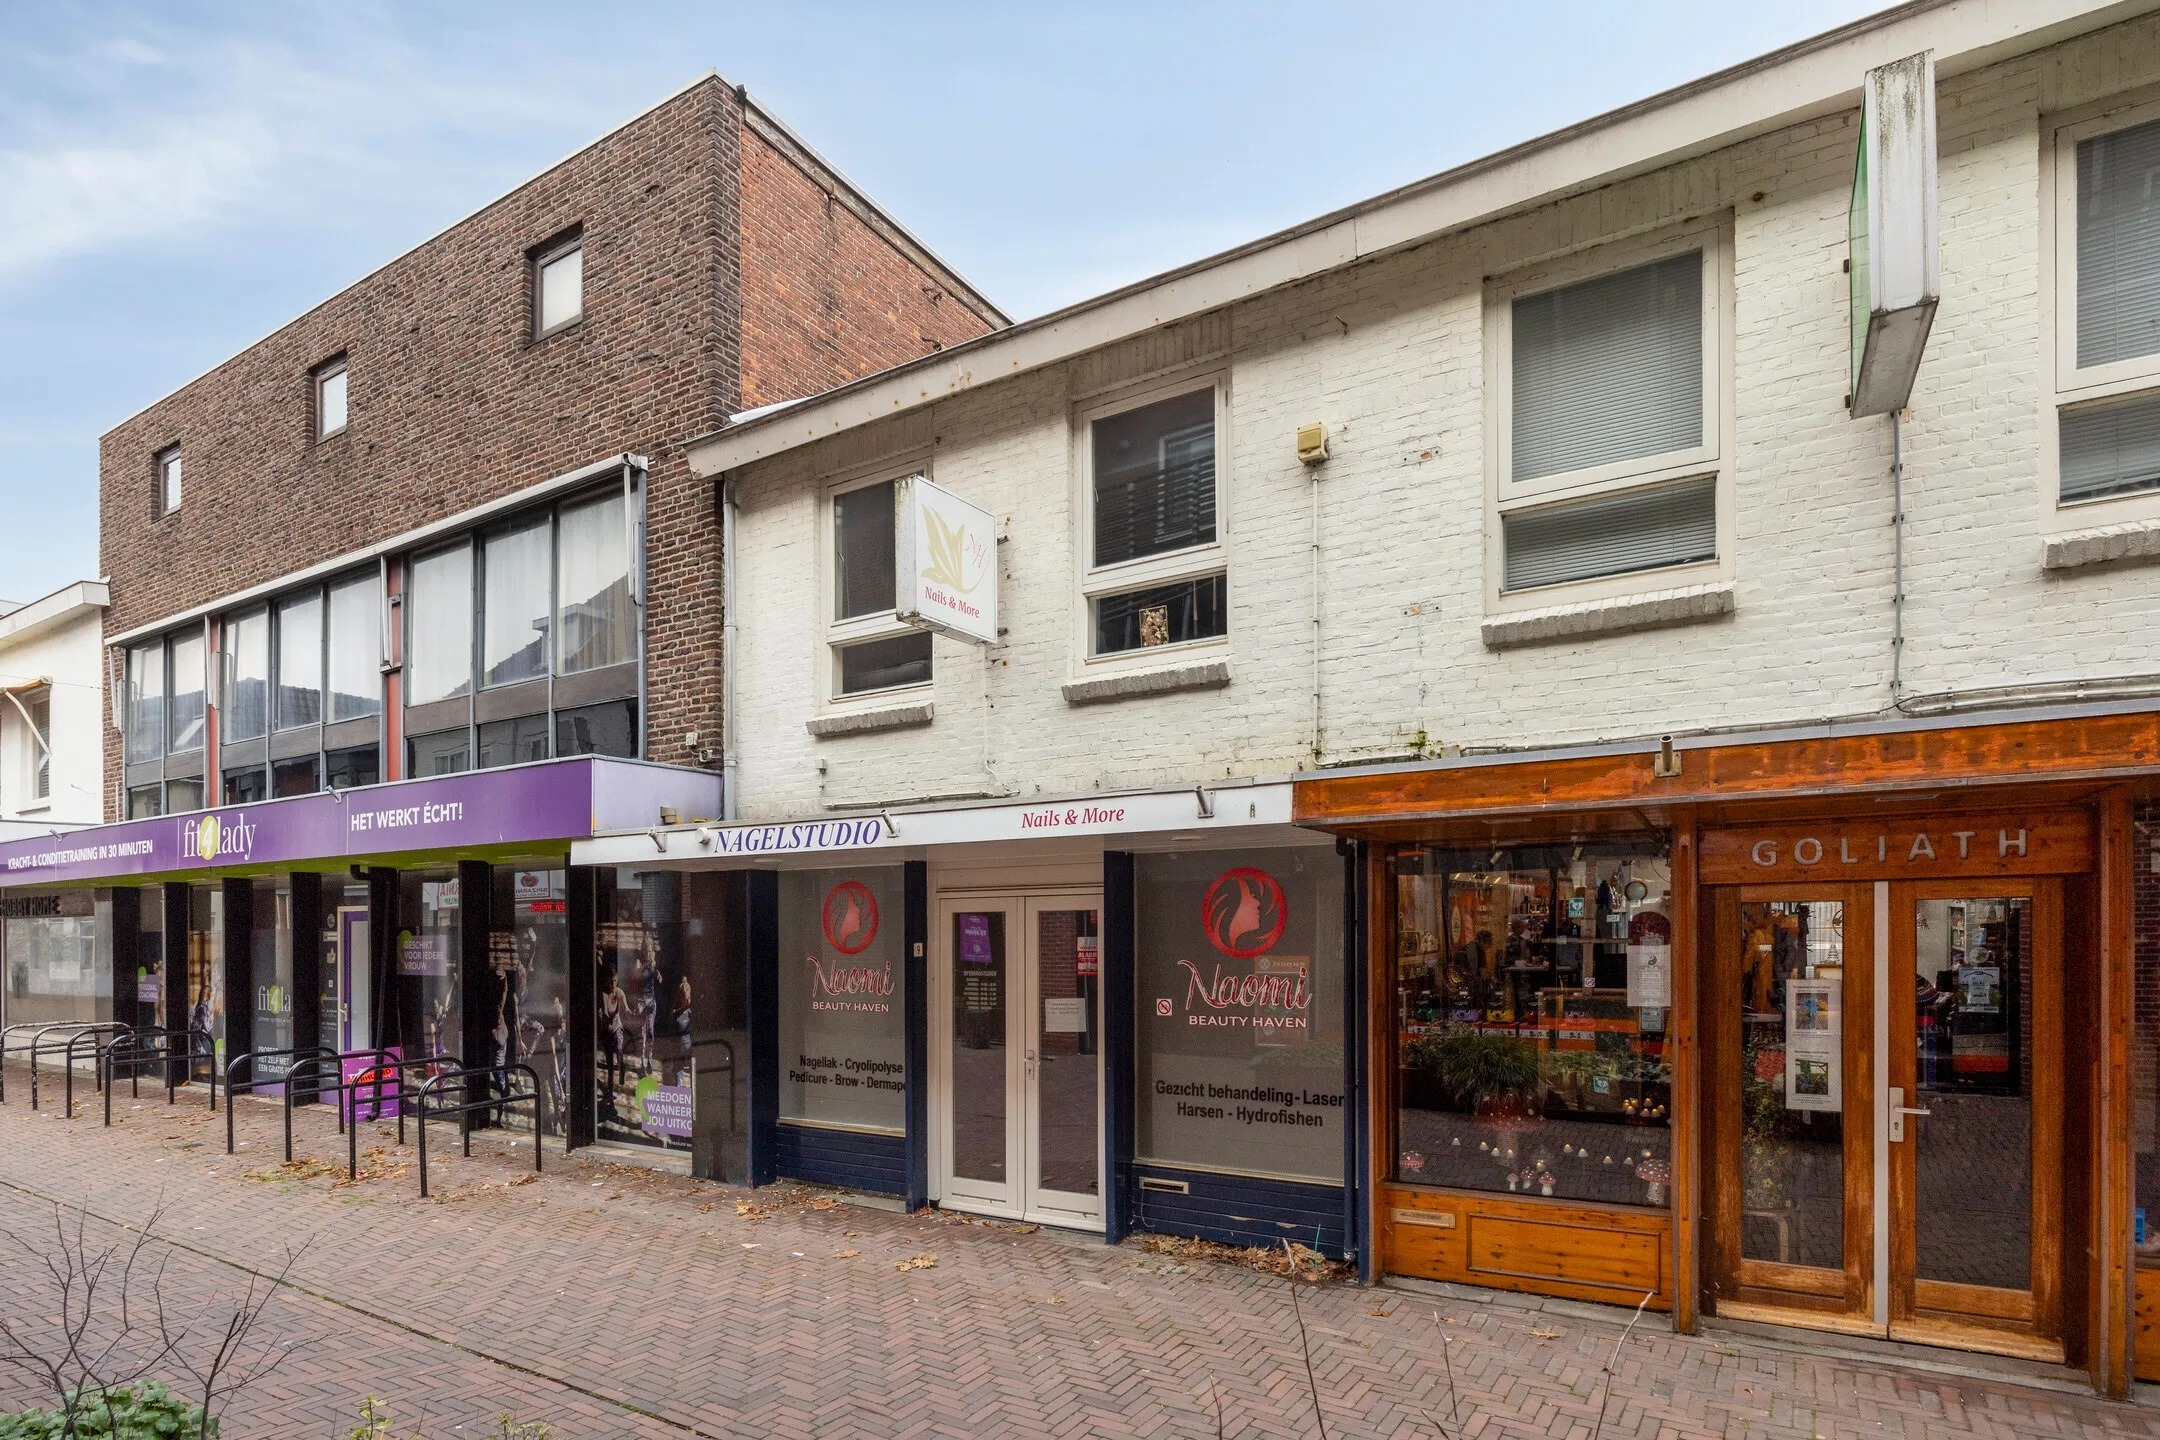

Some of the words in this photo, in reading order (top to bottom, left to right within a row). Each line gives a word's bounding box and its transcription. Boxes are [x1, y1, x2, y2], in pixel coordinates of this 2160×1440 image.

[925, 586, 947, 606] Nails
[948, 596, 956, 609] &
[958, 600, 980, 619] More
[351, 812, 374, 831] HET
[376, 807, 420, 829] WERKT
[423, 801, 463, 824] ÉCHT!
[1021, 810, 1060, 829] Nails
[1064, 809, 1078, 825] &
[1081, 807, 1125, 824] More
[183, 813, 256, 861] fit4lady
[714, 819, 881, 853] NAGELSTUDIO
[8, 857, 31, 870] KRACHT-
[32, 856, 38, 867] &
[38, 847, 98, 866] CONDITIETRAINING
[99, 845, 107, 859] IN
[108, 844, 117, 858] 30
[118, 839, 153, 857] MINUTEN
[1751, 829, 2027, 867] GOLIATH
[404, 940, 433, 950] GESCHIKT
[404, 951, 422, 959] VOOR
[423, 951, 444, 960] IEDERE
[404, 962, 427, 970] VROUW
[807, 956, 895, 998] Naomi
[1177, 959, 1313, 1010] Naomi
[812, 1001, 852, 1011] BEAUTY
[854, 1003, 889, 1012] HAVEN
[1189, 1015, 1249, 1026] BEAUTY
[1252, 1017, 1307, 1028] HAVEN
[258, 1063, 268, 1072] EEN
[800, 1055, 837, 1070] Nagellak
[845, 1058, 903, 1075] Cryolipolyse
[789, 1070, 828, 1085] Pedicure
[835, 1074, 859, 1087] Brow
[647, 1090, 691, 1105] MEEDOEN
[1155, 1080, 1205, 1097] Gezicht
[1303, 1090, 1345, 1106] Laser
[647, 1103, 691, 1117] WANNEER
[1177, 1102, 1224, 1119] Harsen
[1236, 1106, 1323, 1127] Hydrofishen
[647, 1115, 665, 1127] JOU
